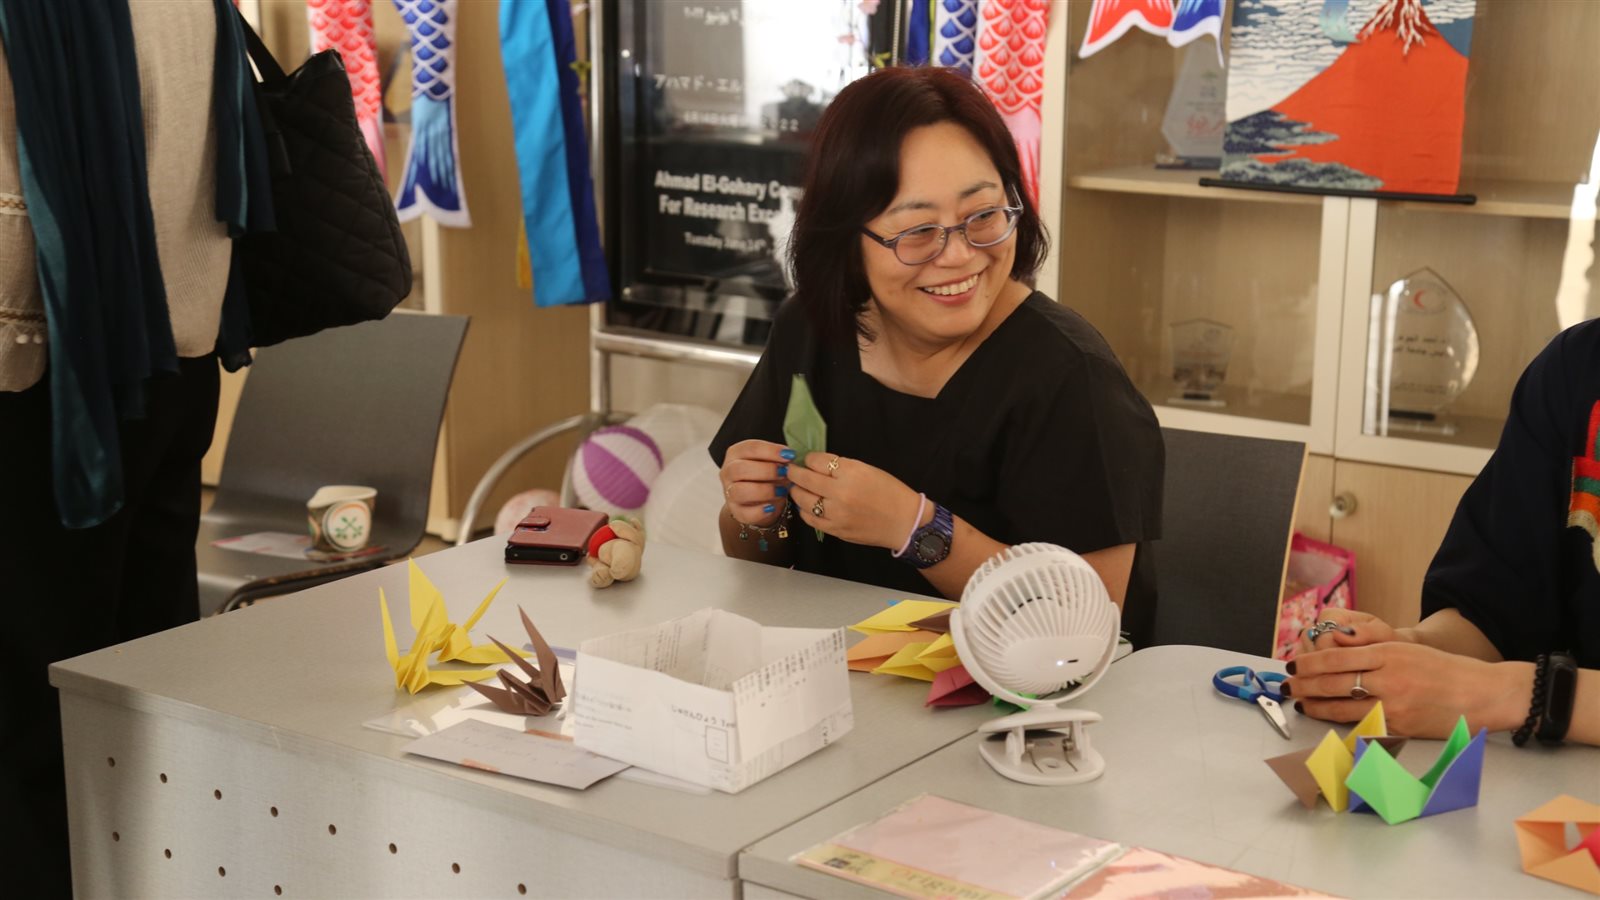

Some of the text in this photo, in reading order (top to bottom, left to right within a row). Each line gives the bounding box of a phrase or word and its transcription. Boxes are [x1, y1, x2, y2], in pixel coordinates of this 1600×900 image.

[655, 170, 700, 191] Ahmad
[701, 174, 767, 201] El-Gohary
[659, 194, 682, 214] For
[683, 197, 746, 221] Research
